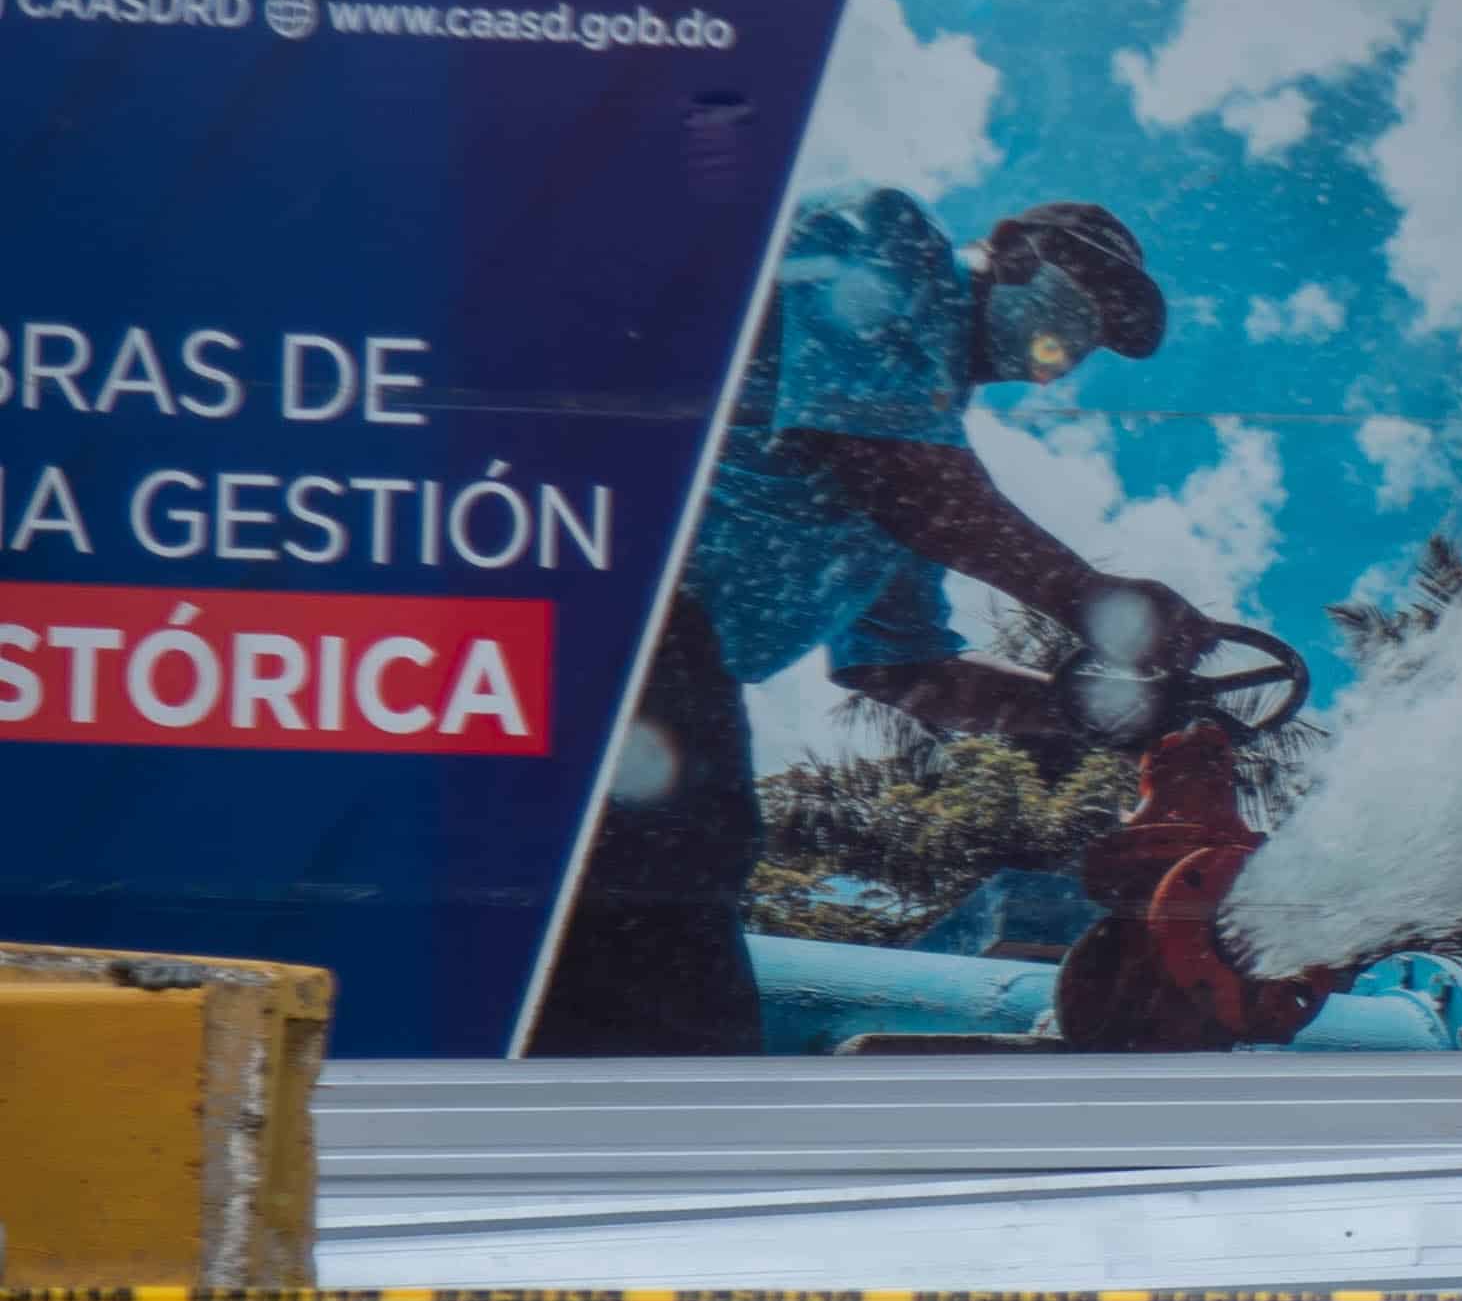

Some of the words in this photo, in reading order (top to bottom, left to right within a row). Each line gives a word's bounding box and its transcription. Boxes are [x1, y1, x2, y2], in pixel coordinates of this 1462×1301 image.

[327, 1, 736, 51] www.caasd.gob.do
[0, 321, 245, 419] RAS
[281, 333, 430, 427] DE
[0, 465, 94, 555] A
[130, 460, 611, 570] GESTIÓN
